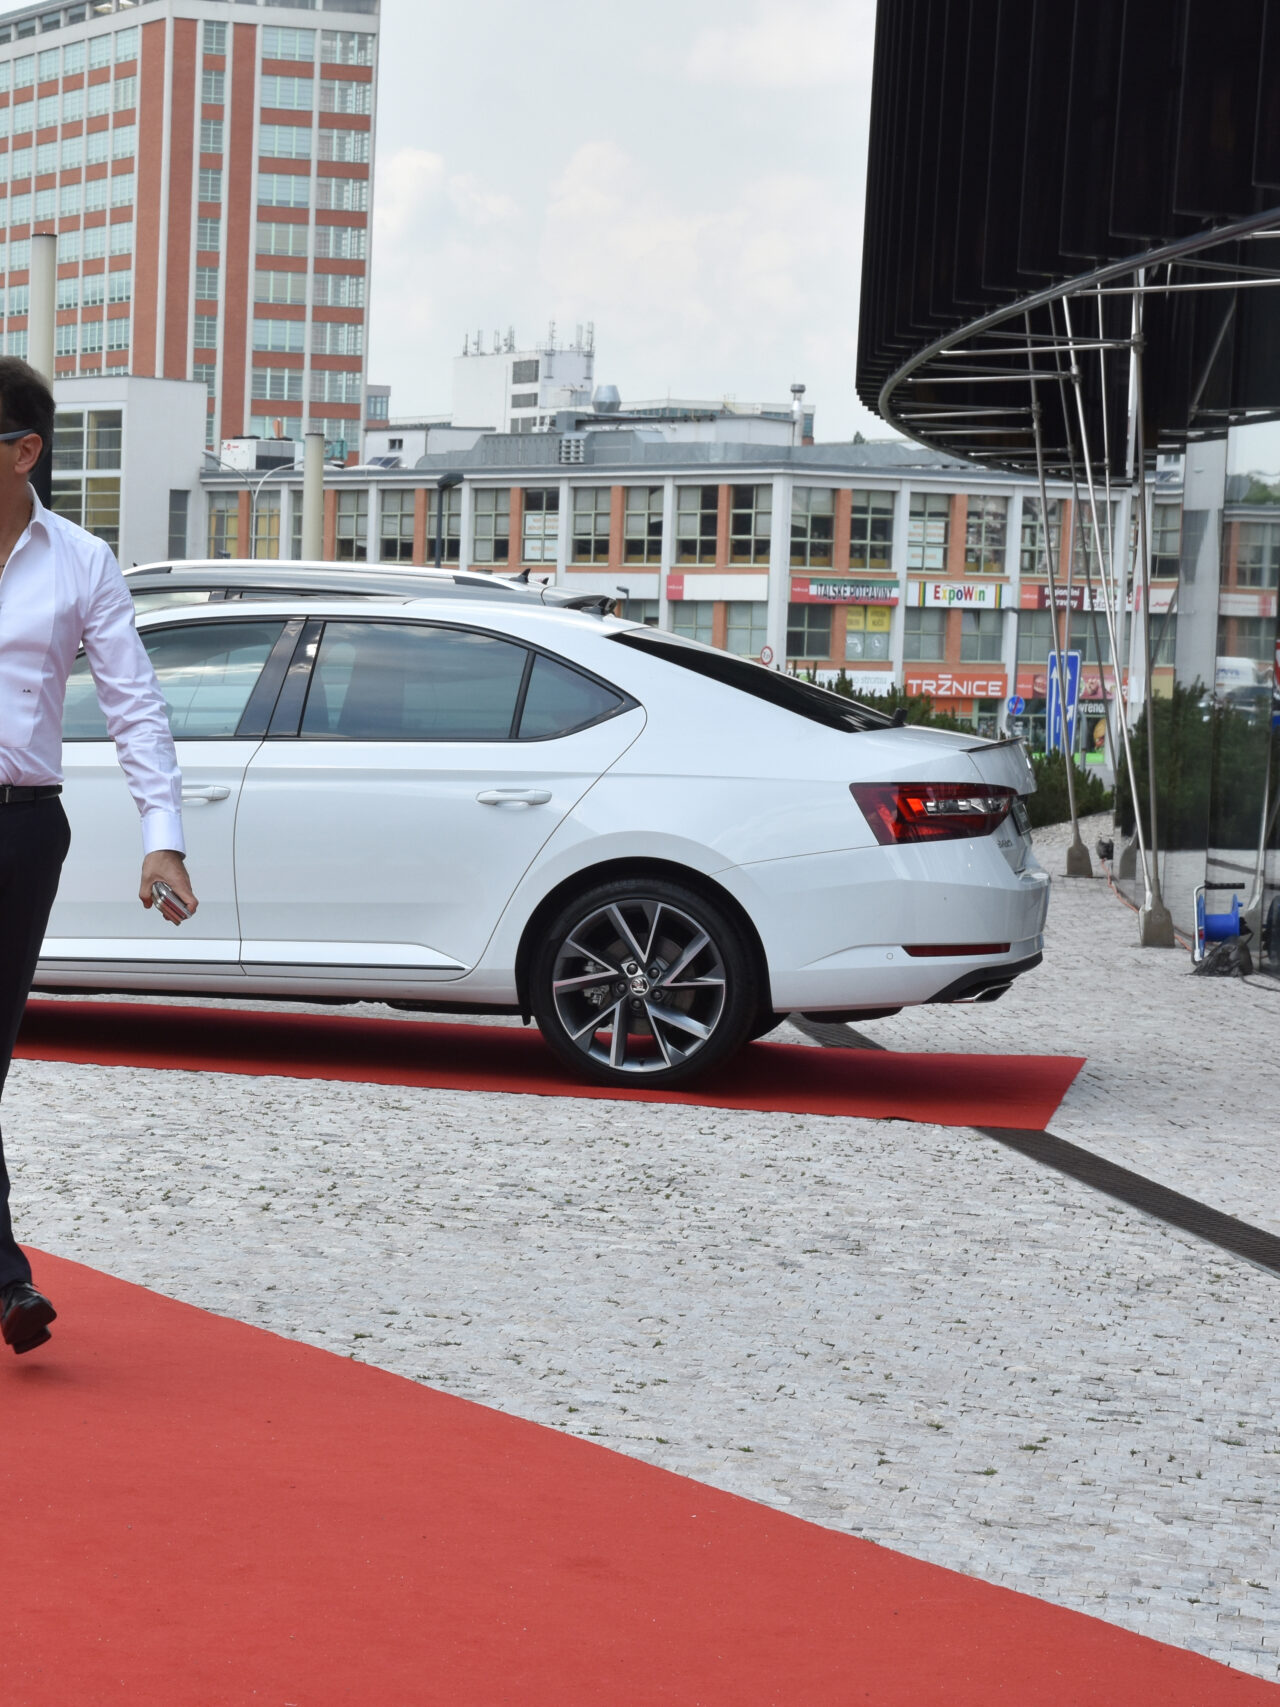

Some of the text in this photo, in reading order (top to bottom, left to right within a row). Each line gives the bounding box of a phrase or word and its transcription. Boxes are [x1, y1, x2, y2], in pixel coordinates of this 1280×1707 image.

[849, 583, 893, 601] POTRAVINY
[933, 584, 986, 605] ExpoWin
[907, 674, 1002, 696] TRŽNICE
